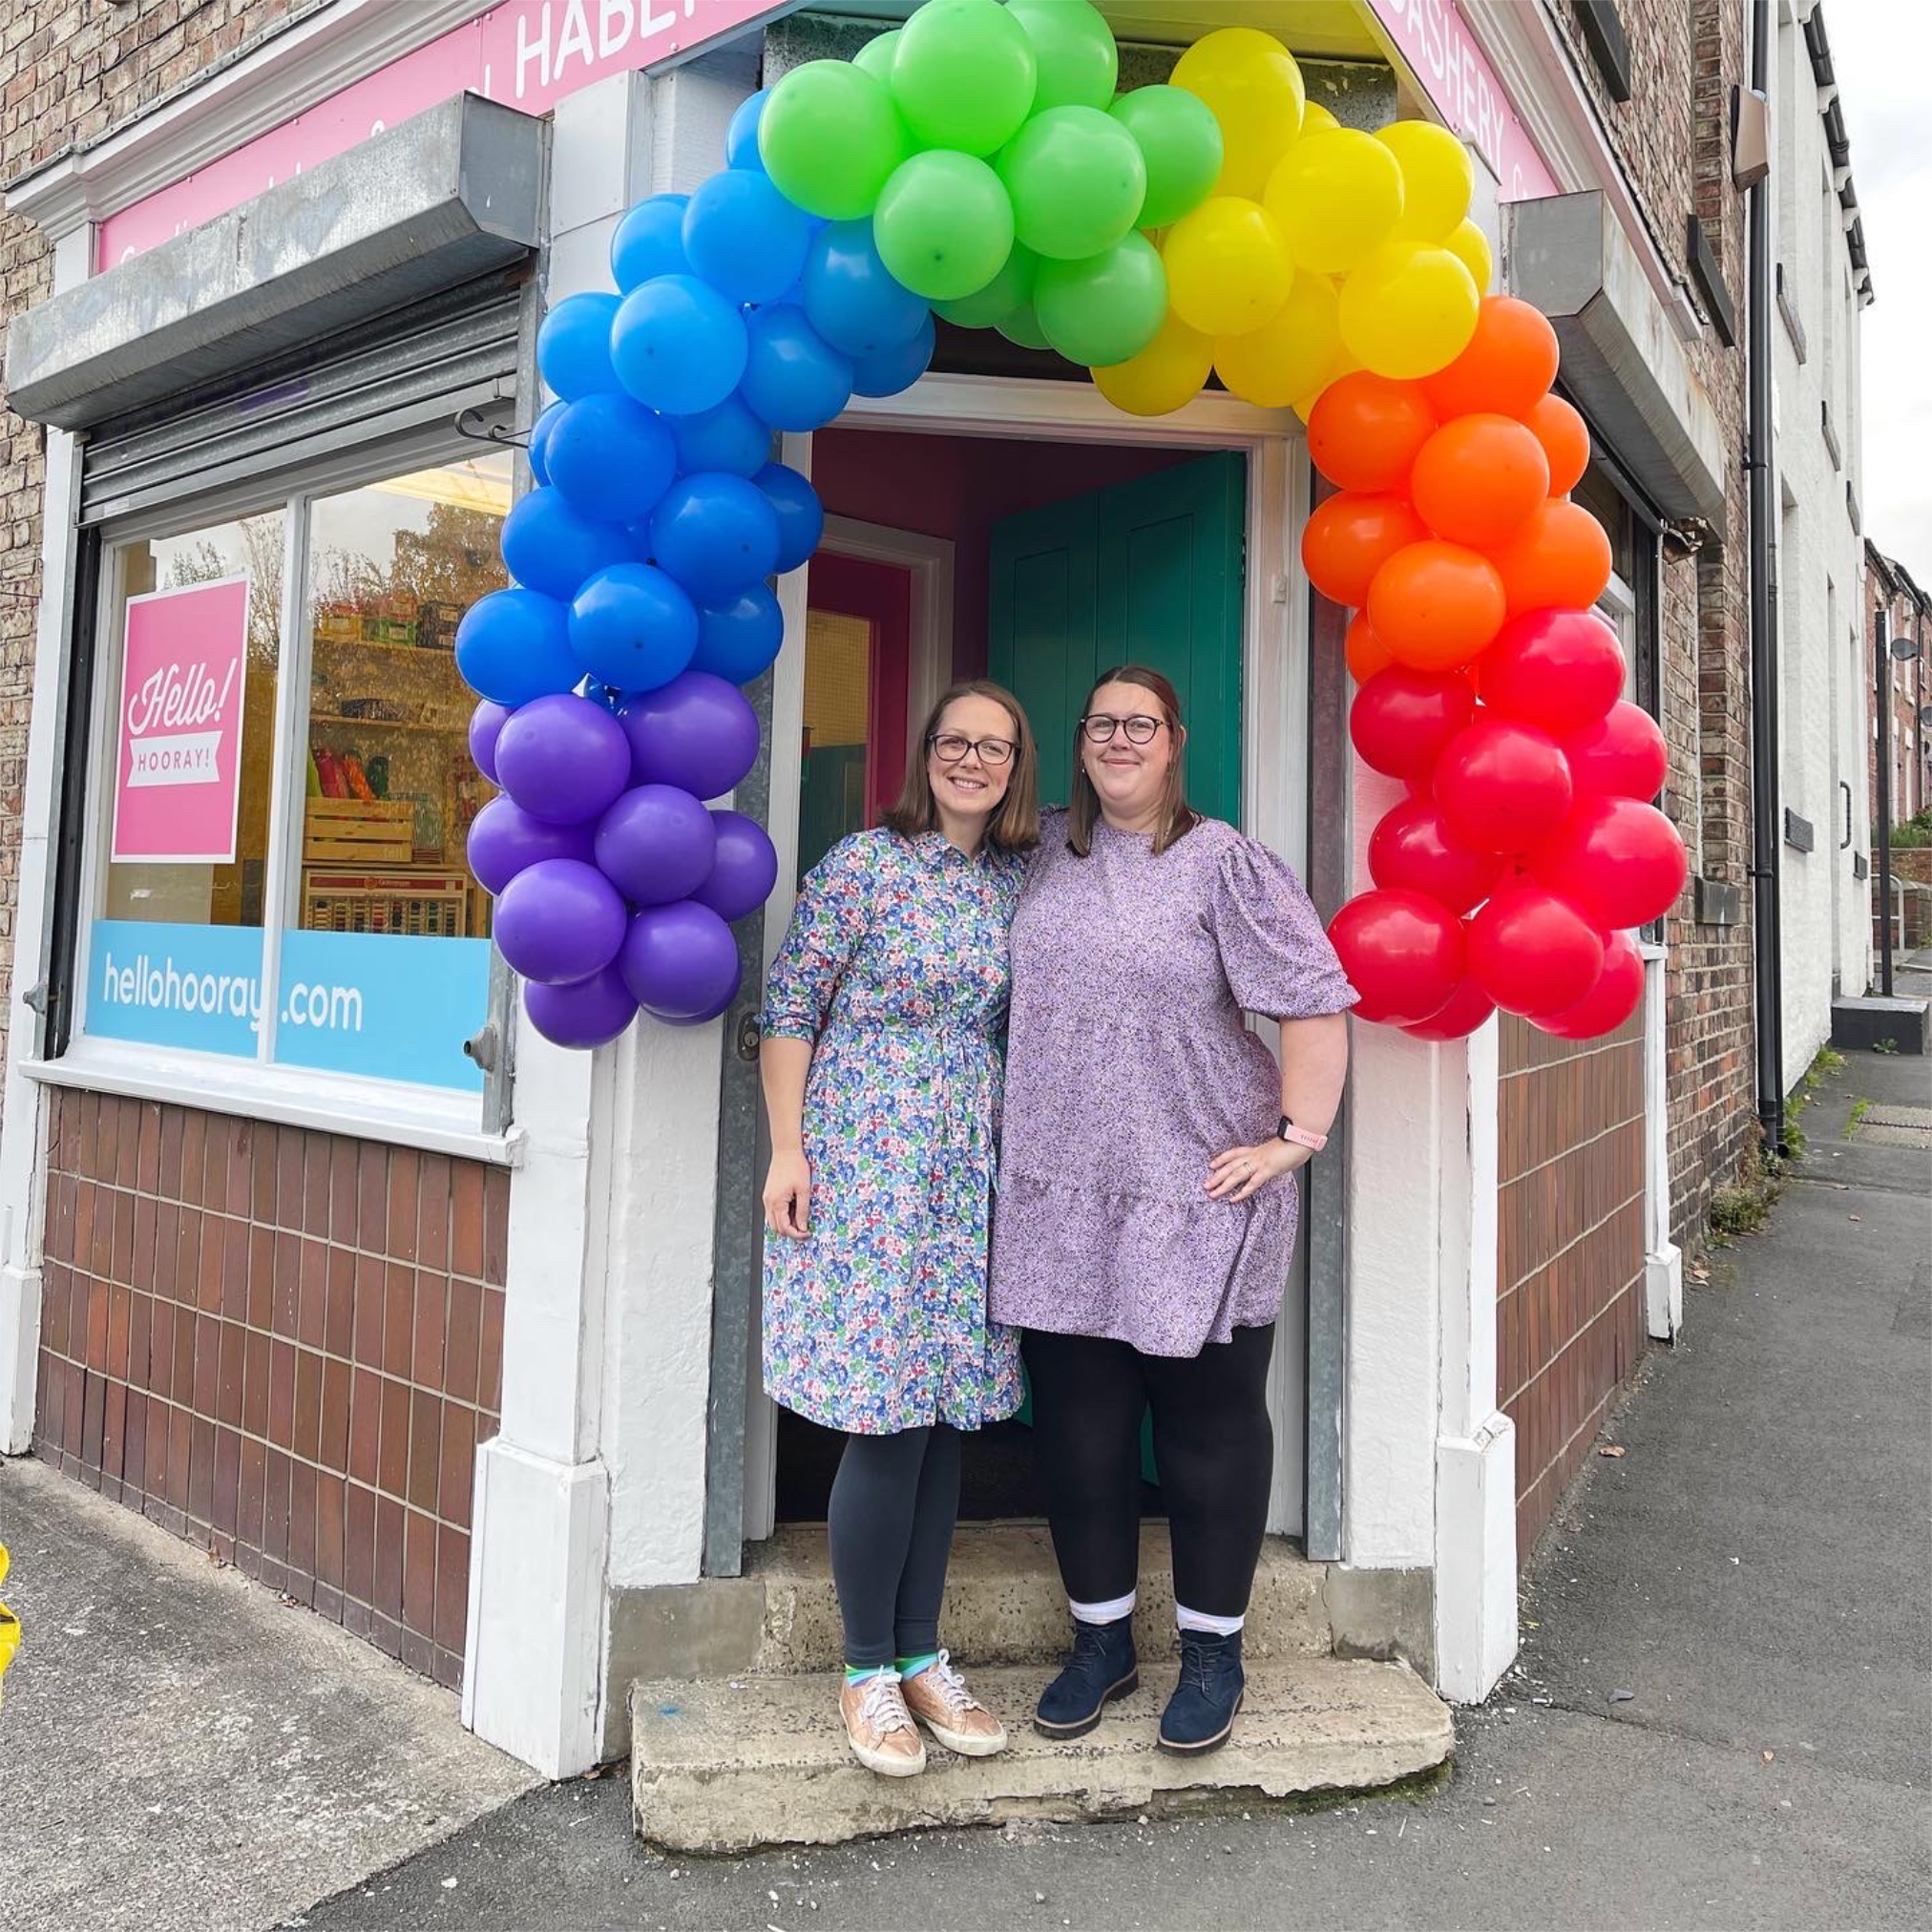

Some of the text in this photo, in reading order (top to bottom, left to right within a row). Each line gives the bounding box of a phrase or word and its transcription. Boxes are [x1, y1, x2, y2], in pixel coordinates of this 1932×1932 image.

[515, 0, 696, 99] HAB
[127, 657, 238, 736] Hello!
[137, 748, 210, 772] HOORAY!
